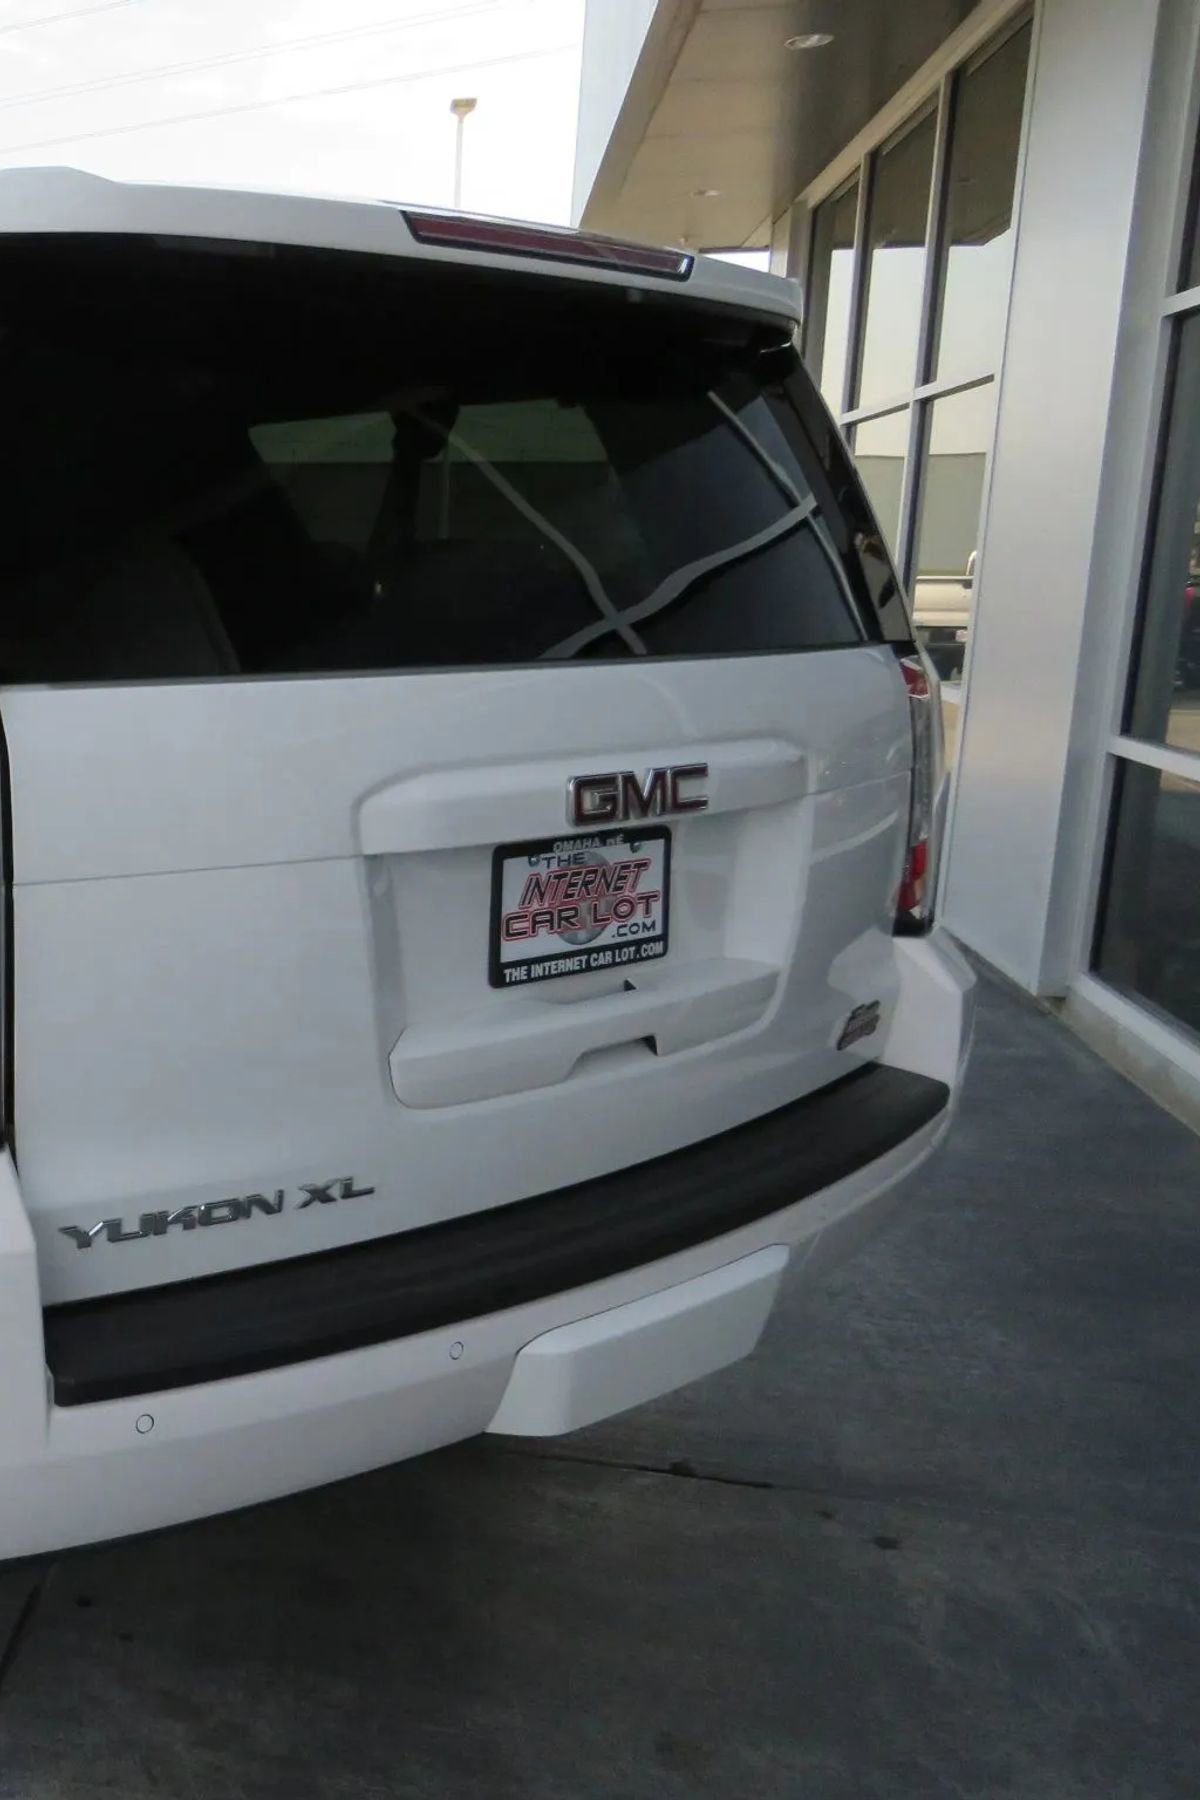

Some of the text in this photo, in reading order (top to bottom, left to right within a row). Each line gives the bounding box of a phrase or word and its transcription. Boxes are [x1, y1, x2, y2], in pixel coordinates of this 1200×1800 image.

[566, 762, 709, 827] GMC
[542, 853, 586, 870] THE
[553, 837, 600, 853] OMAHA
[519, 858, 651, 910] INTERNET
[503, 890, 661, 942] CAR LOT
[611, 919, 657, 939] .COM
[503, 966, 528, 983] THE
[530, 955, 589, 978] INTERNET
[589, 948, 613, 967] CAR
[59, 1176, 375, 1249] YUKON XL
